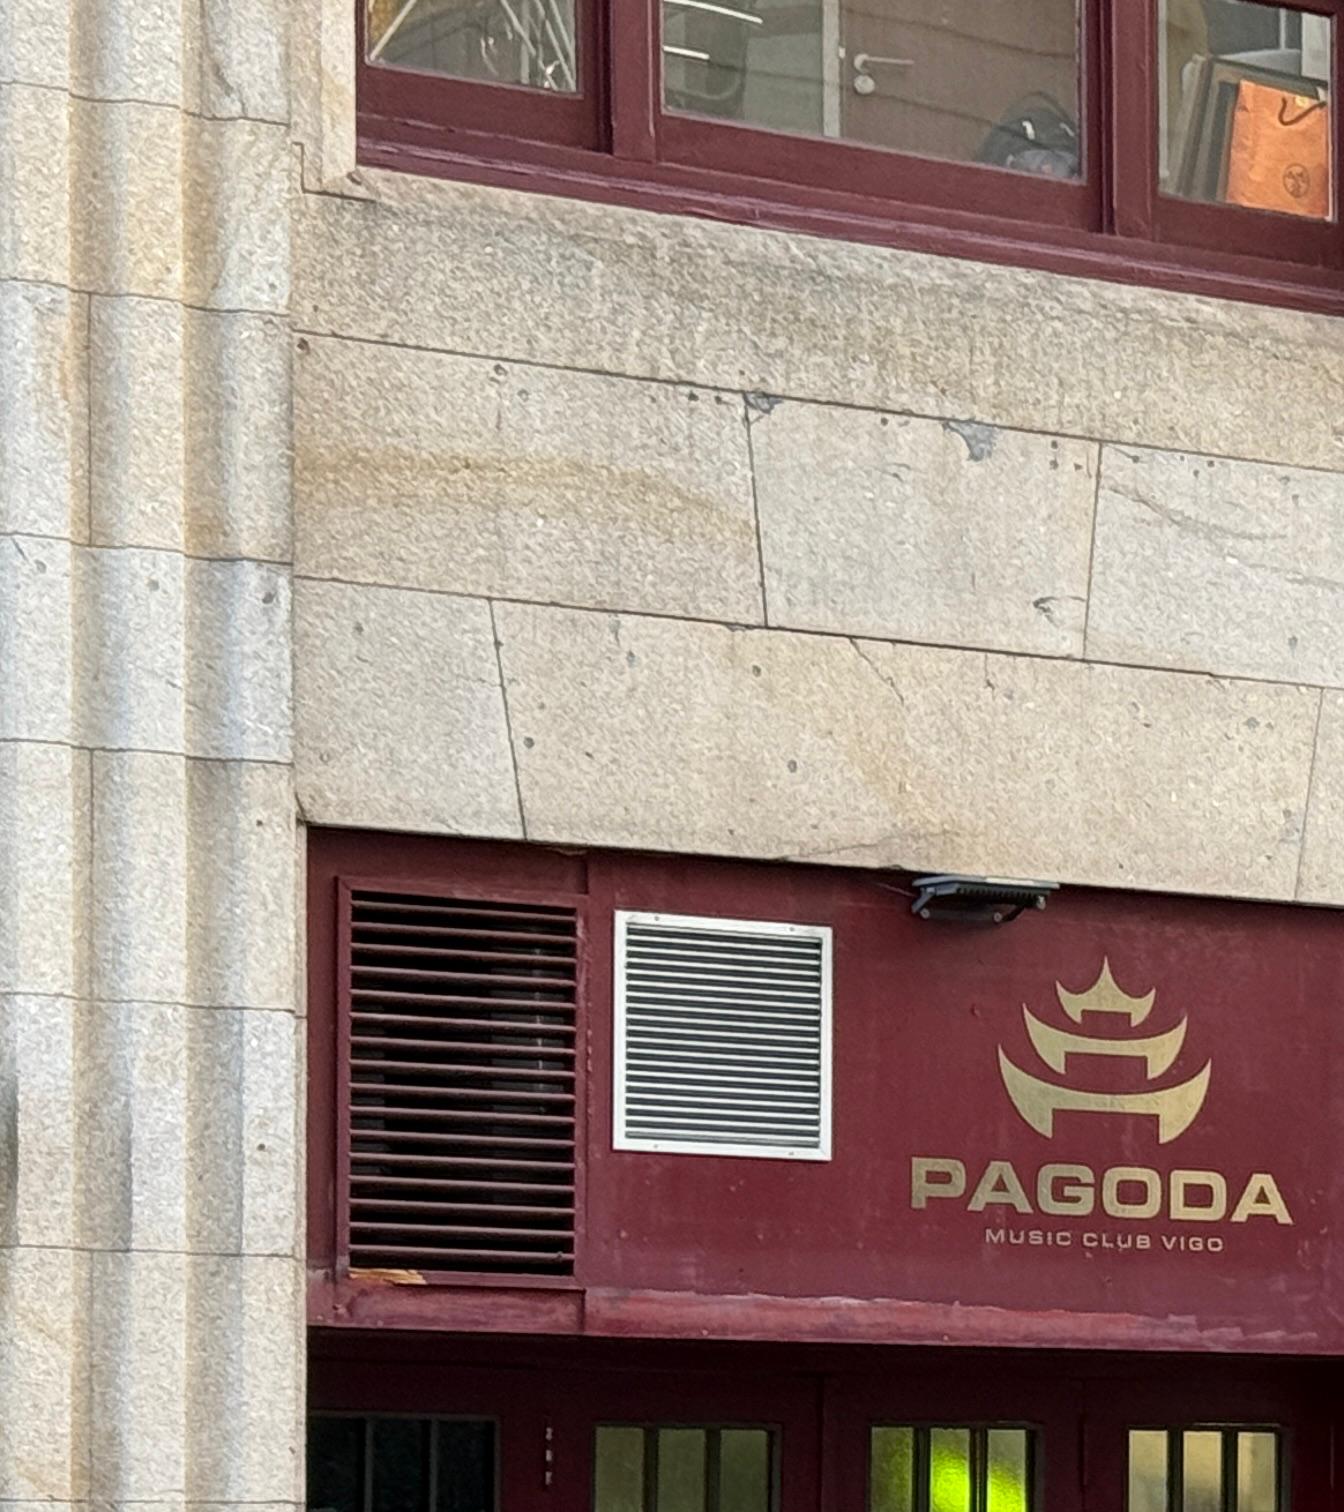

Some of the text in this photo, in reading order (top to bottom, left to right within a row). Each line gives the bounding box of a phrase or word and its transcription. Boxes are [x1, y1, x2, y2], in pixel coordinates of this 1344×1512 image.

[910, 1157, 1293, 1225] PAGODA
[985, 1227, 1224, 1253] MUSIC CLUB VIGO
